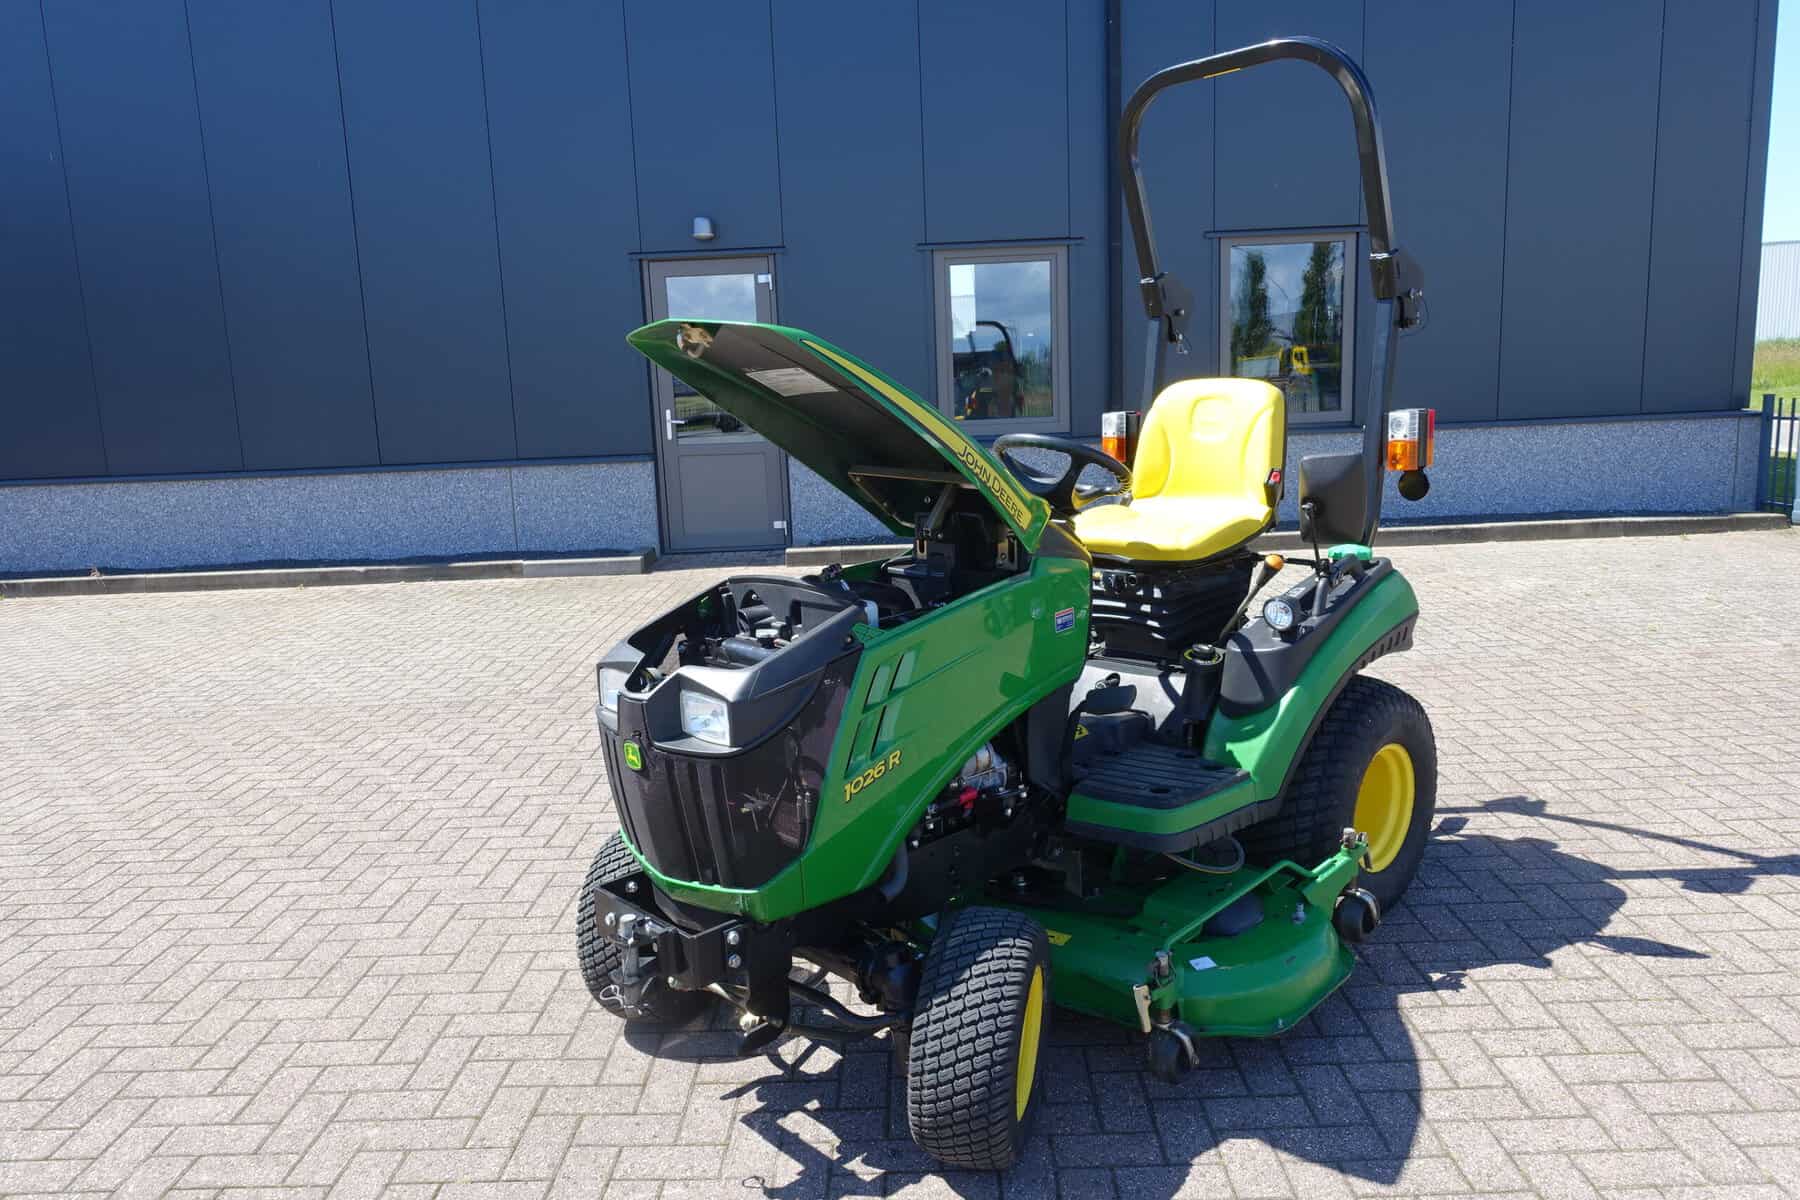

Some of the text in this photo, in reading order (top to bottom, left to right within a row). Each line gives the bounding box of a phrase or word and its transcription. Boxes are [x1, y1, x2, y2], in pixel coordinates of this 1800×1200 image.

[959, 446, 1024, 525] JOHN DEERE
[844, 760, 886, 802] 1026
